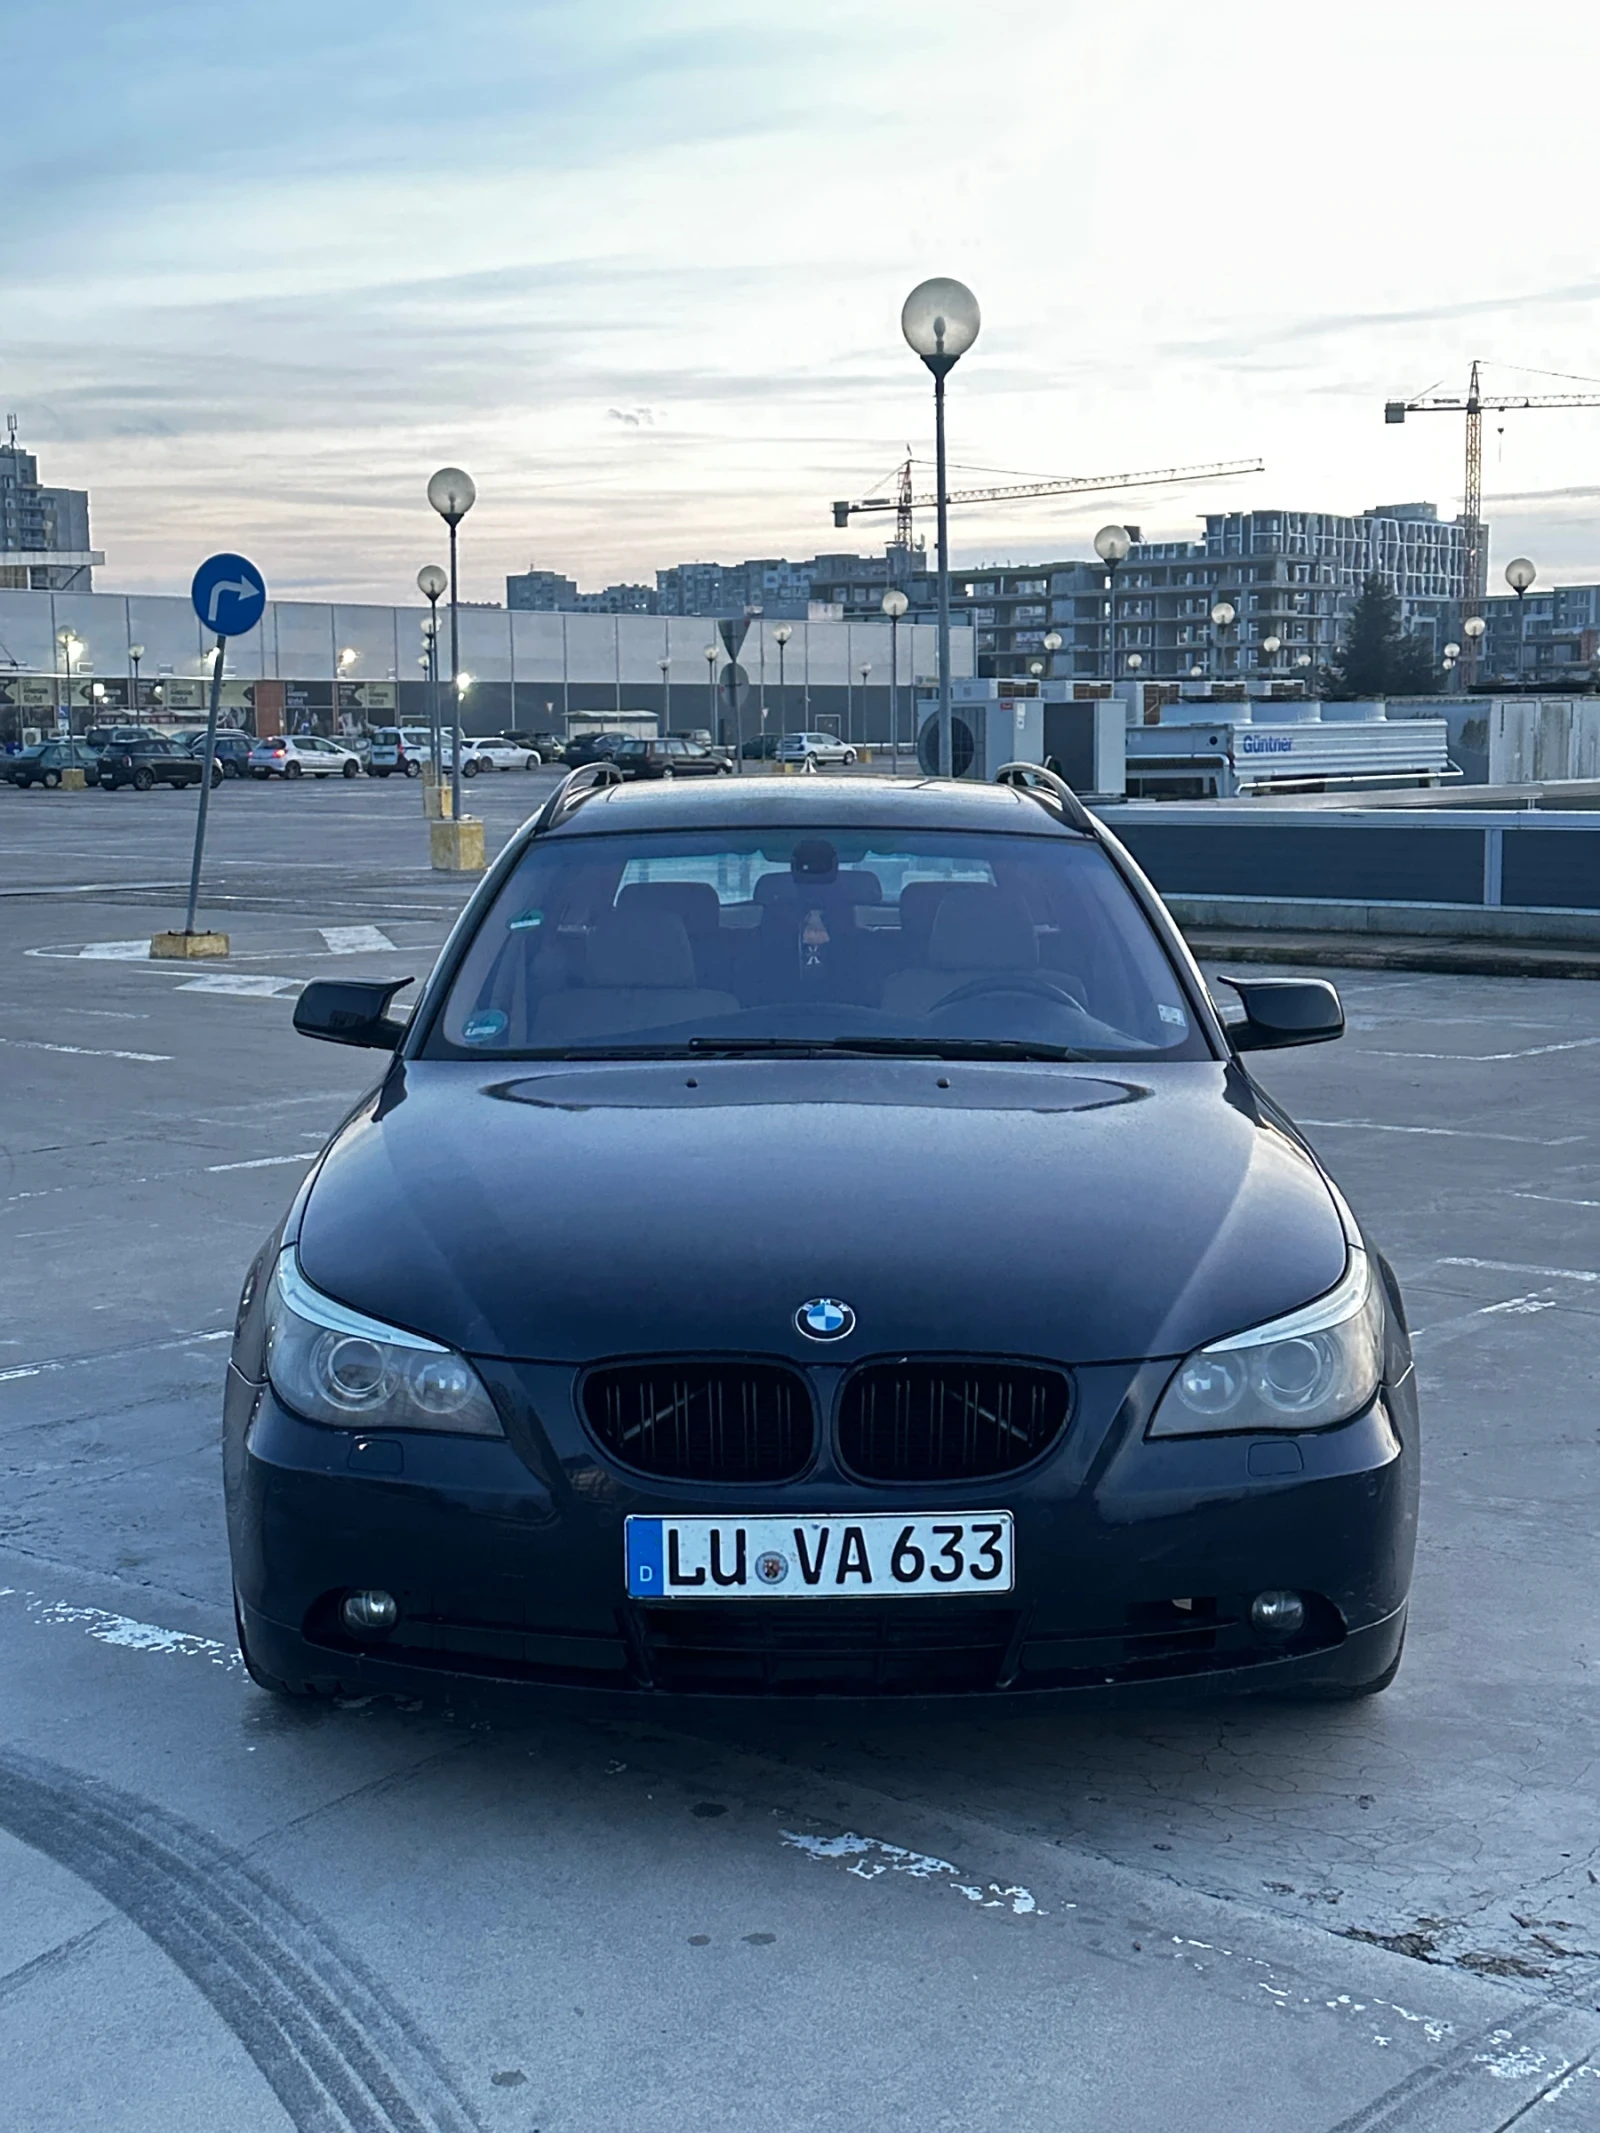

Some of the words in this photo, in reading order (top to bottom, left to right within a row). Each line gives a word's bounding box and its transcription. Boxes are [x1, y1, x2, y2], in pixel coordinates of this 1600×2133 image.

[1243, 734, 1293, 753] Güntner
[802, 1299, 850, 1312] BMW
[668, 1529, 747, 1586] LU
[793, 1526, 872, 1585] VA
[890, 1524, 1003, 1583] 633
[639, 1565, 653, 1582] D
